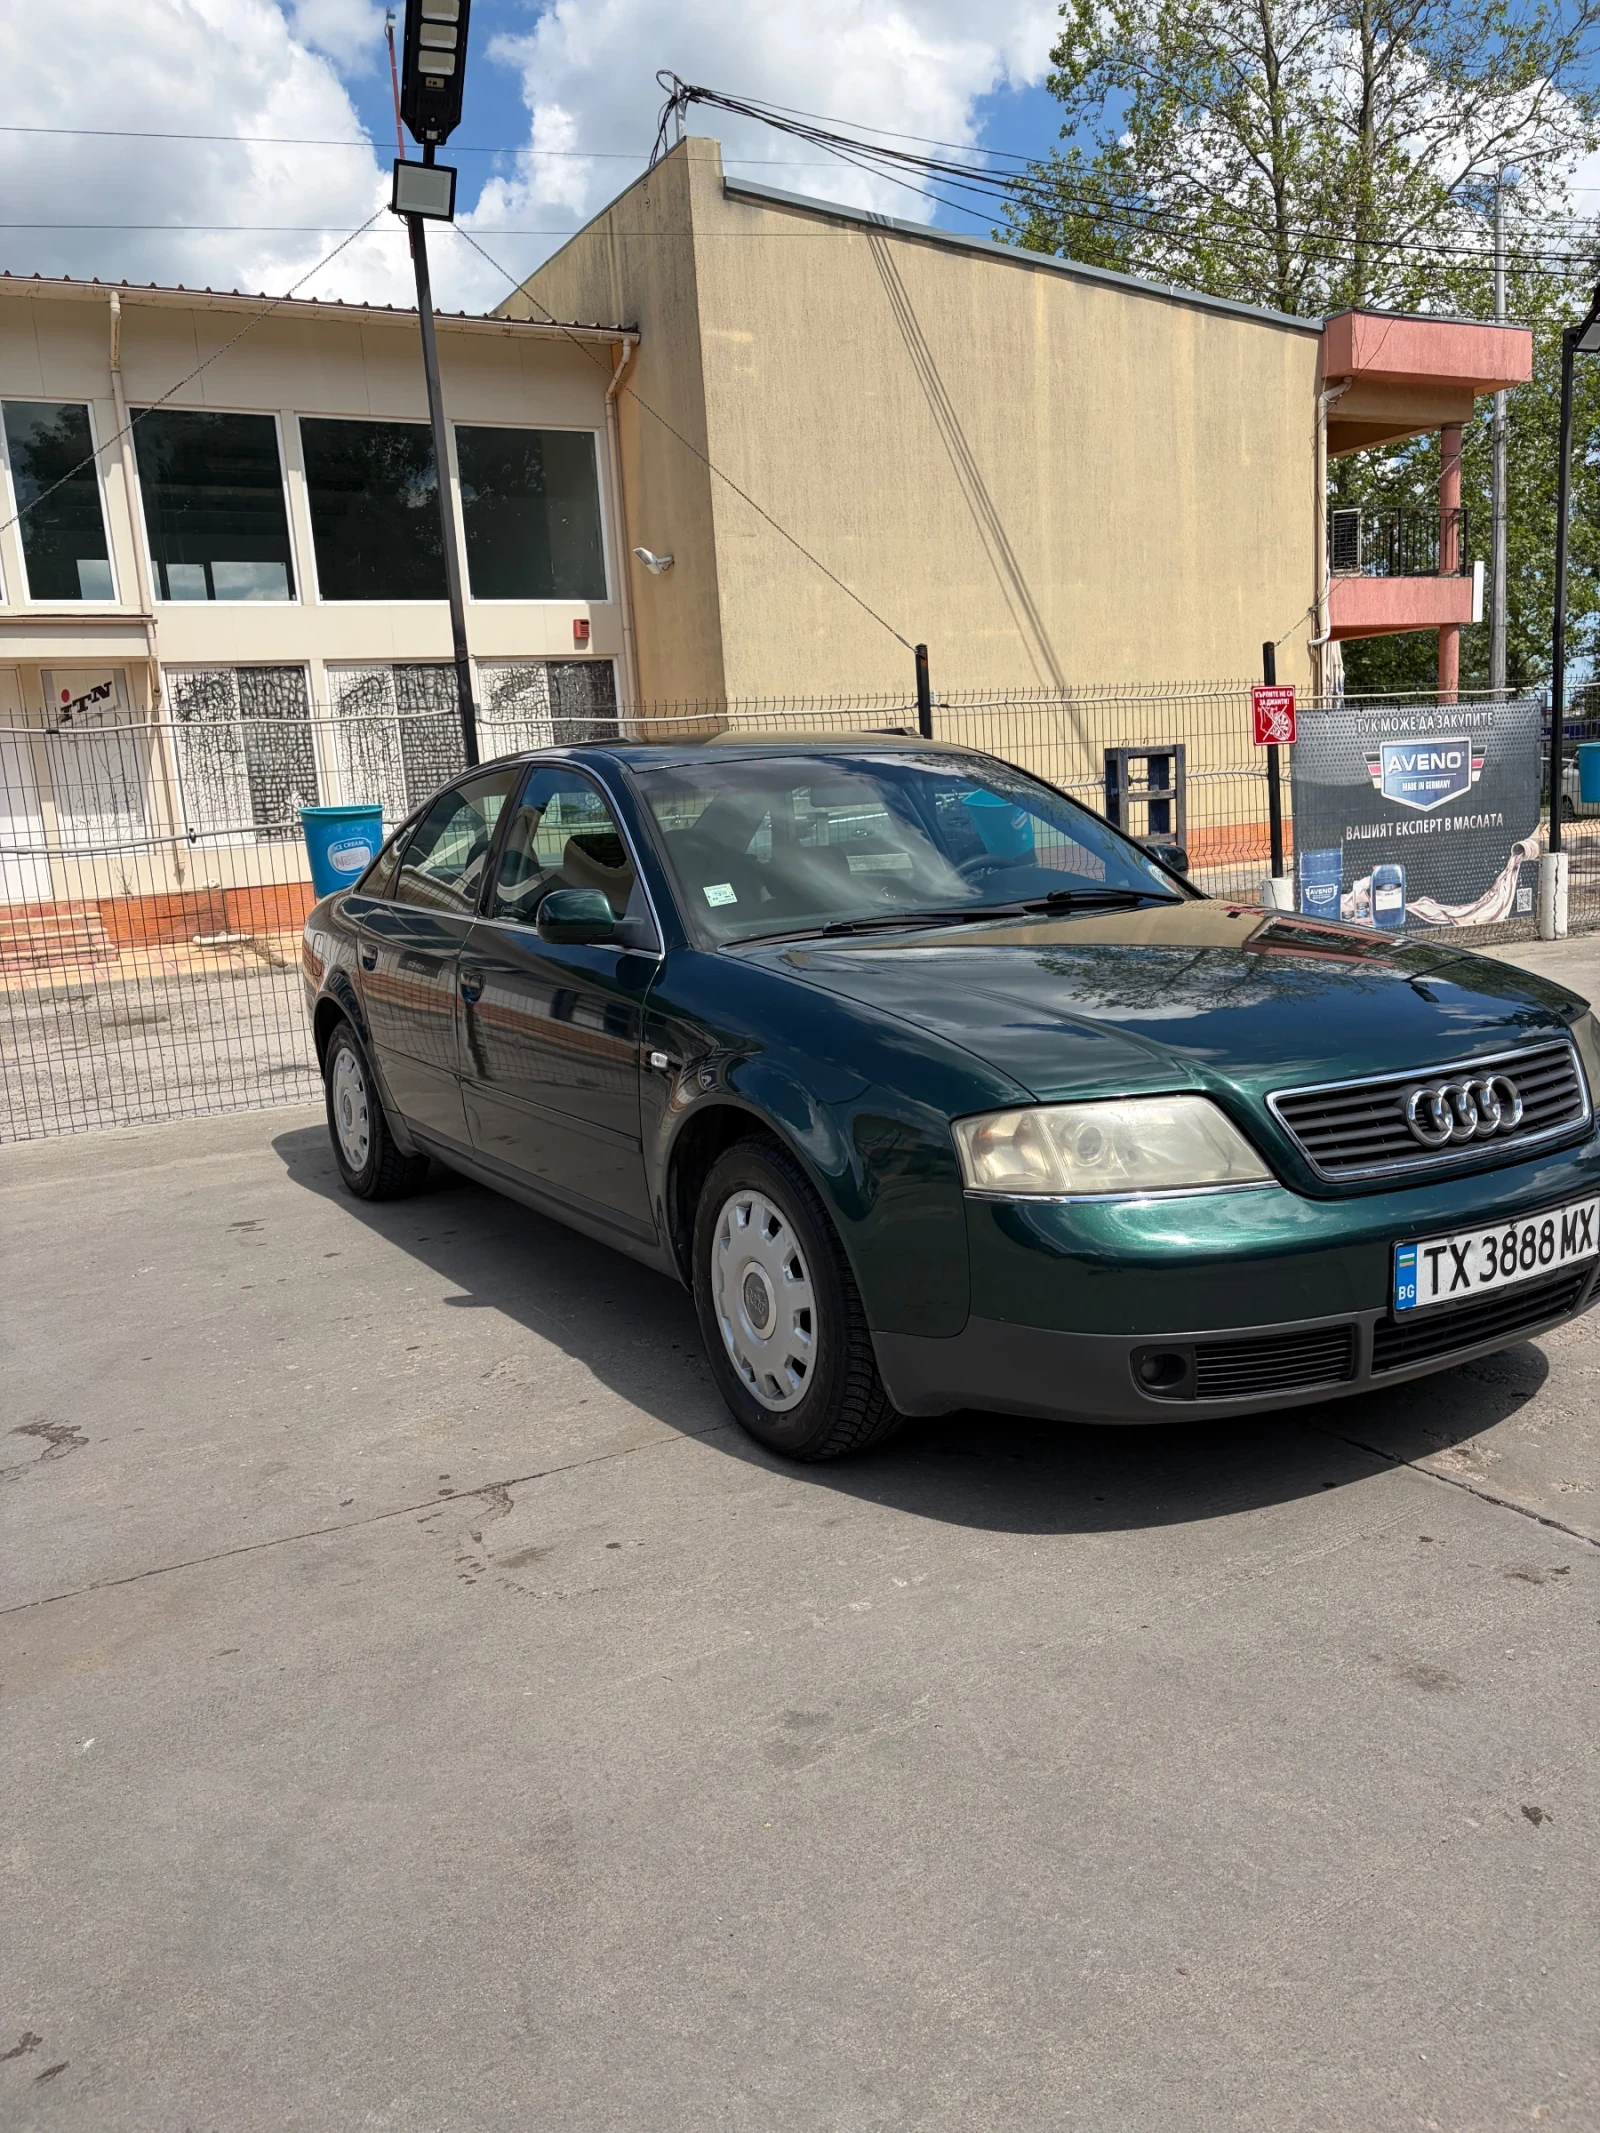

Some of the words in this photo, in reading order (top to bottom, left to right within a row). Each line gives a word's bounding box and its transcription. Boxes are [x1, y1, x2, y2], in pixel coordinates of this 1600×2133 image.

[1356, 718, 1378, 732] ТУК
[1381, 716, 1416, 732] МОЖЕ
[1419, 715, 1434, 730] ДА
[1437, 712, 1493, 729] ЗАКУПИТЕ
[1388, 751, 1461, 773] AVENO
[1402, 782, 1417, 792] MADE
[1418, 782, 1425, 791] IN
[1426, 780, 1451, 790] GERMANY
[1346, 823, 1394, 840] ВАШИЯТ
[1396, 818, 1443, 836] ЕКСПЕРТ
[1445, 818, 1451, 831] В
[1453, 813, 1503, 830] МАСЛАТА
[343, 840, 364, 849] CREAM
[1423, 1240, 1471, 1295] TX
[1479, 1219, 1555, 1282] 3888
[1560, 1204, 1595, 1260] MX
[1398, 1284, 1414, 1300] BG
